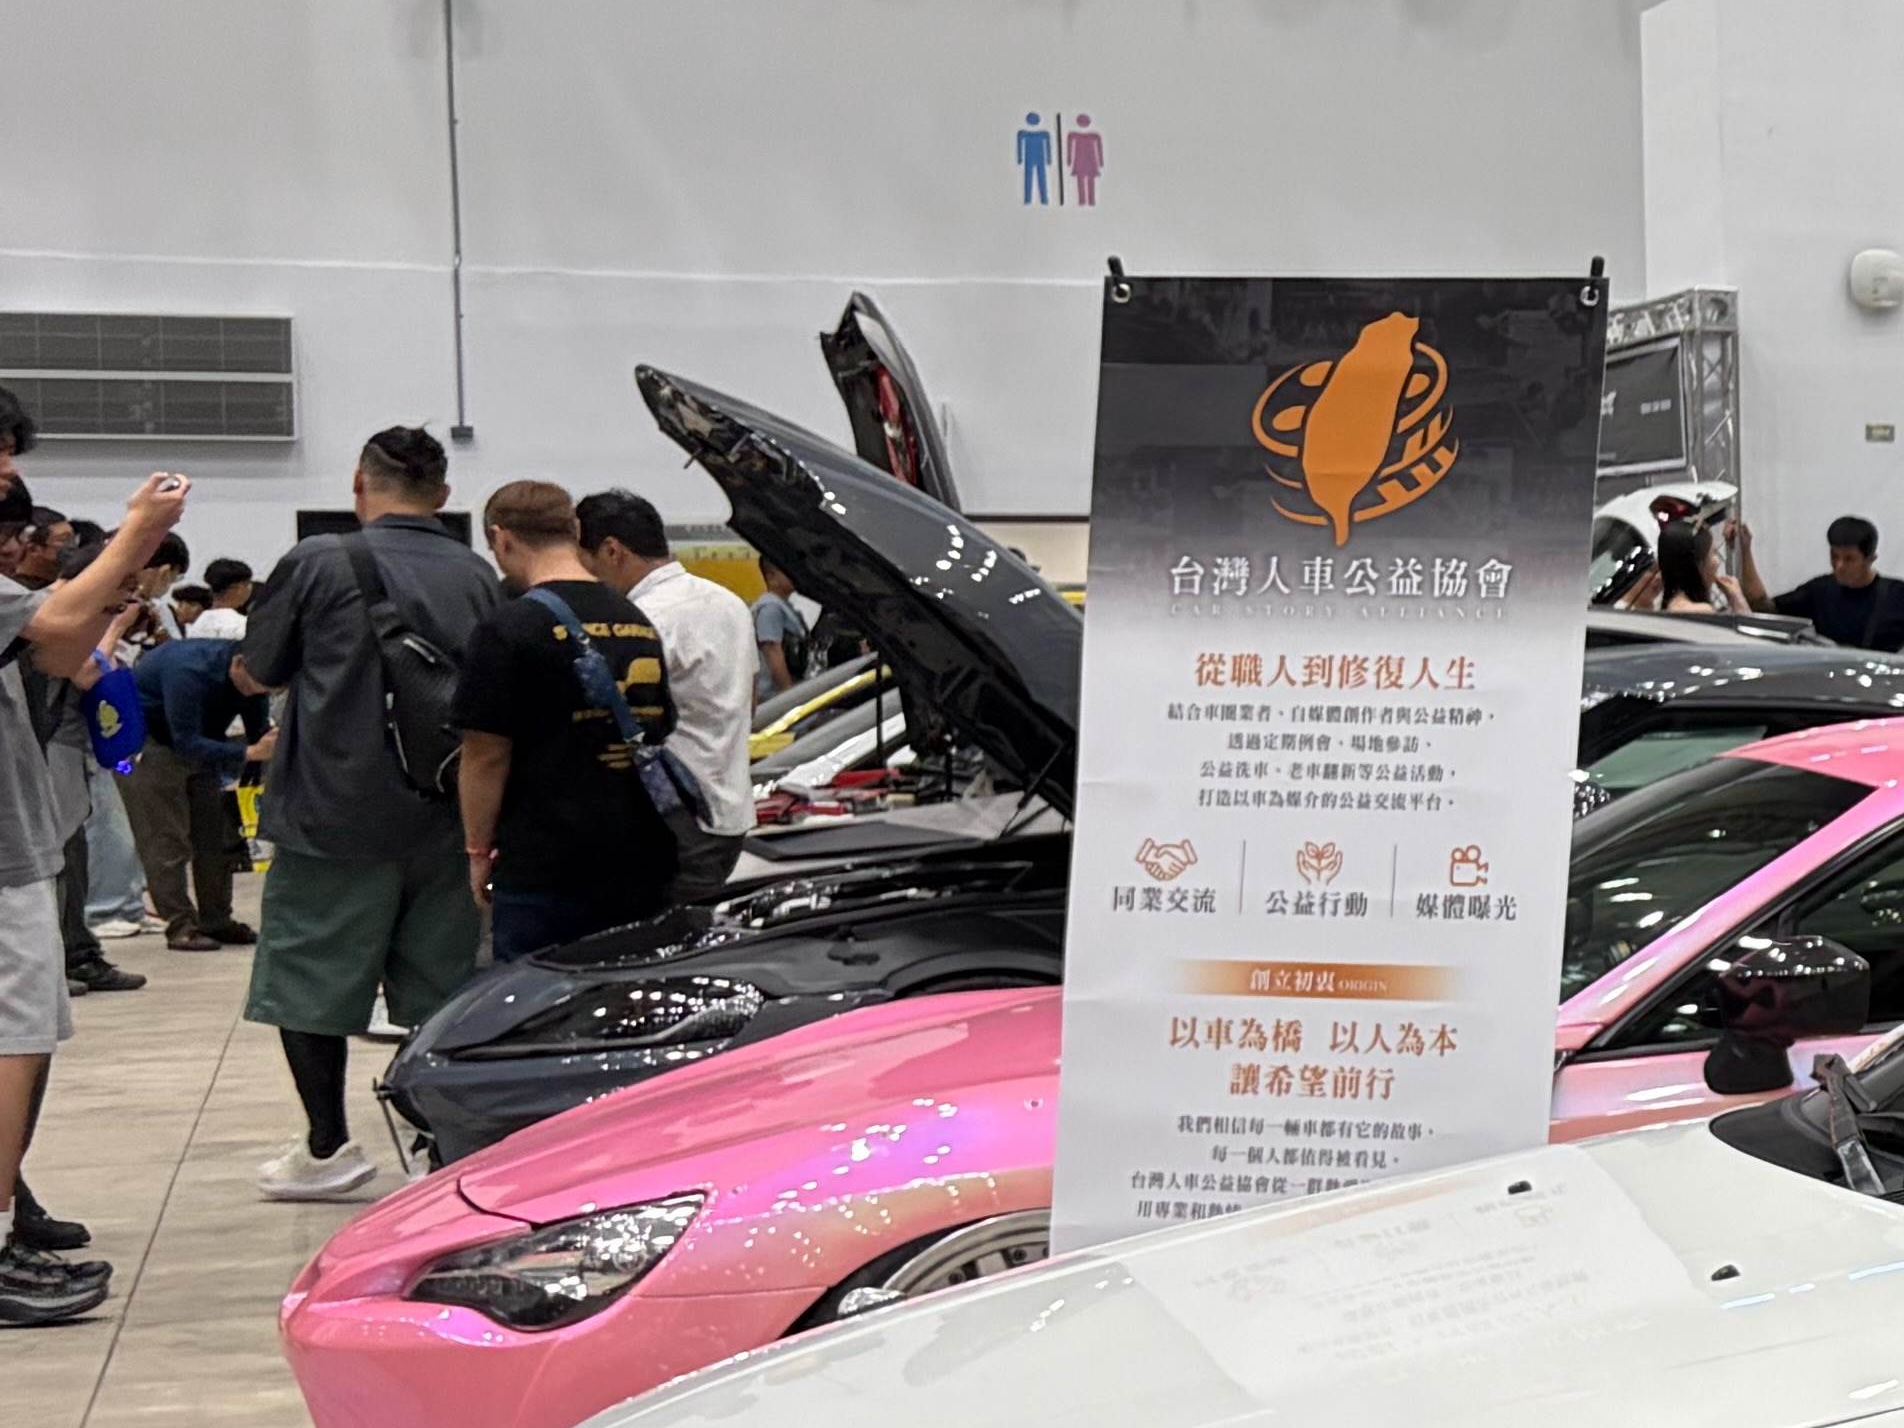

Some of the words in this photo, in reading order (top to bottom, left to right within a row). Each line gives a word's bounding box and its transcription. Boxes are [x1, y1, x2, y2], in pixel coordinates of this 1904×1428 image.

[1171, 555, 1512, 599] 台灣人車公益協會
[1195, 652, 1476, 690] 從職人到修復人生
[1113, 885, 1217, 914] 同業交流
[1265, 891, 1368, 918] 公益行動
[1416, 893, 1517, 921] 媒體曝光
[1250, 969, 1336, 993] 創立初衷
[1169, 1016, 1303, 1052] 以車為橋
[1329, 1021, 1458, 1057] 以人為本
[1230, 1063, 1396, 1100] 讓希望前行
